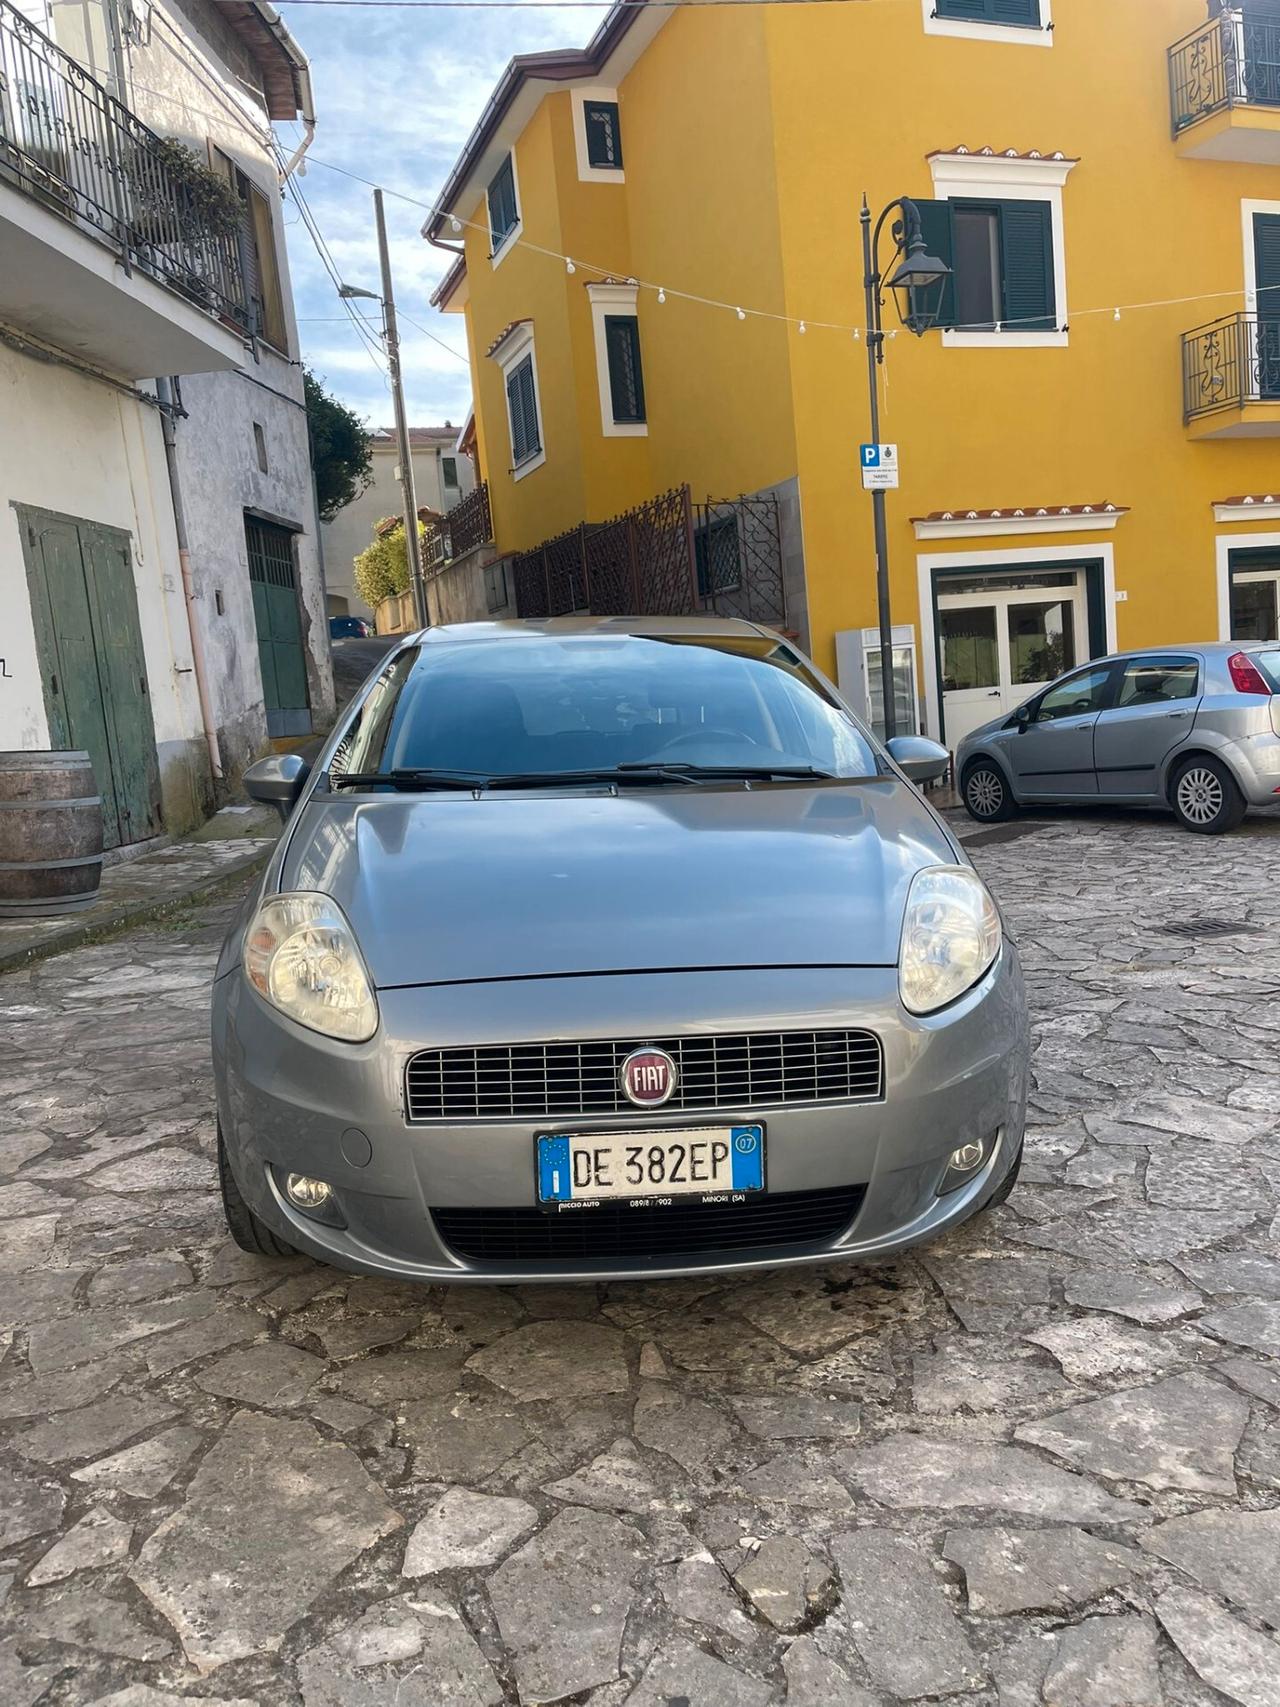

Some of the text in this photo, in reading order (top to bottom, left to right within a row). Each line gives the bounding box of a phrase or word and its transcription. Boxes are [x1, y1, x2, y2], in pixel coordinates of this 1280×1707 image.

[865, 447, 876, 464] P
[633, 1065, 665, 1091] FIAT
[552, 1137, 753, 1194] I DE 382EP 07
[702, 1195, 728, 1204] MINORI
[732, 1194, 746, 1203] (SA)
